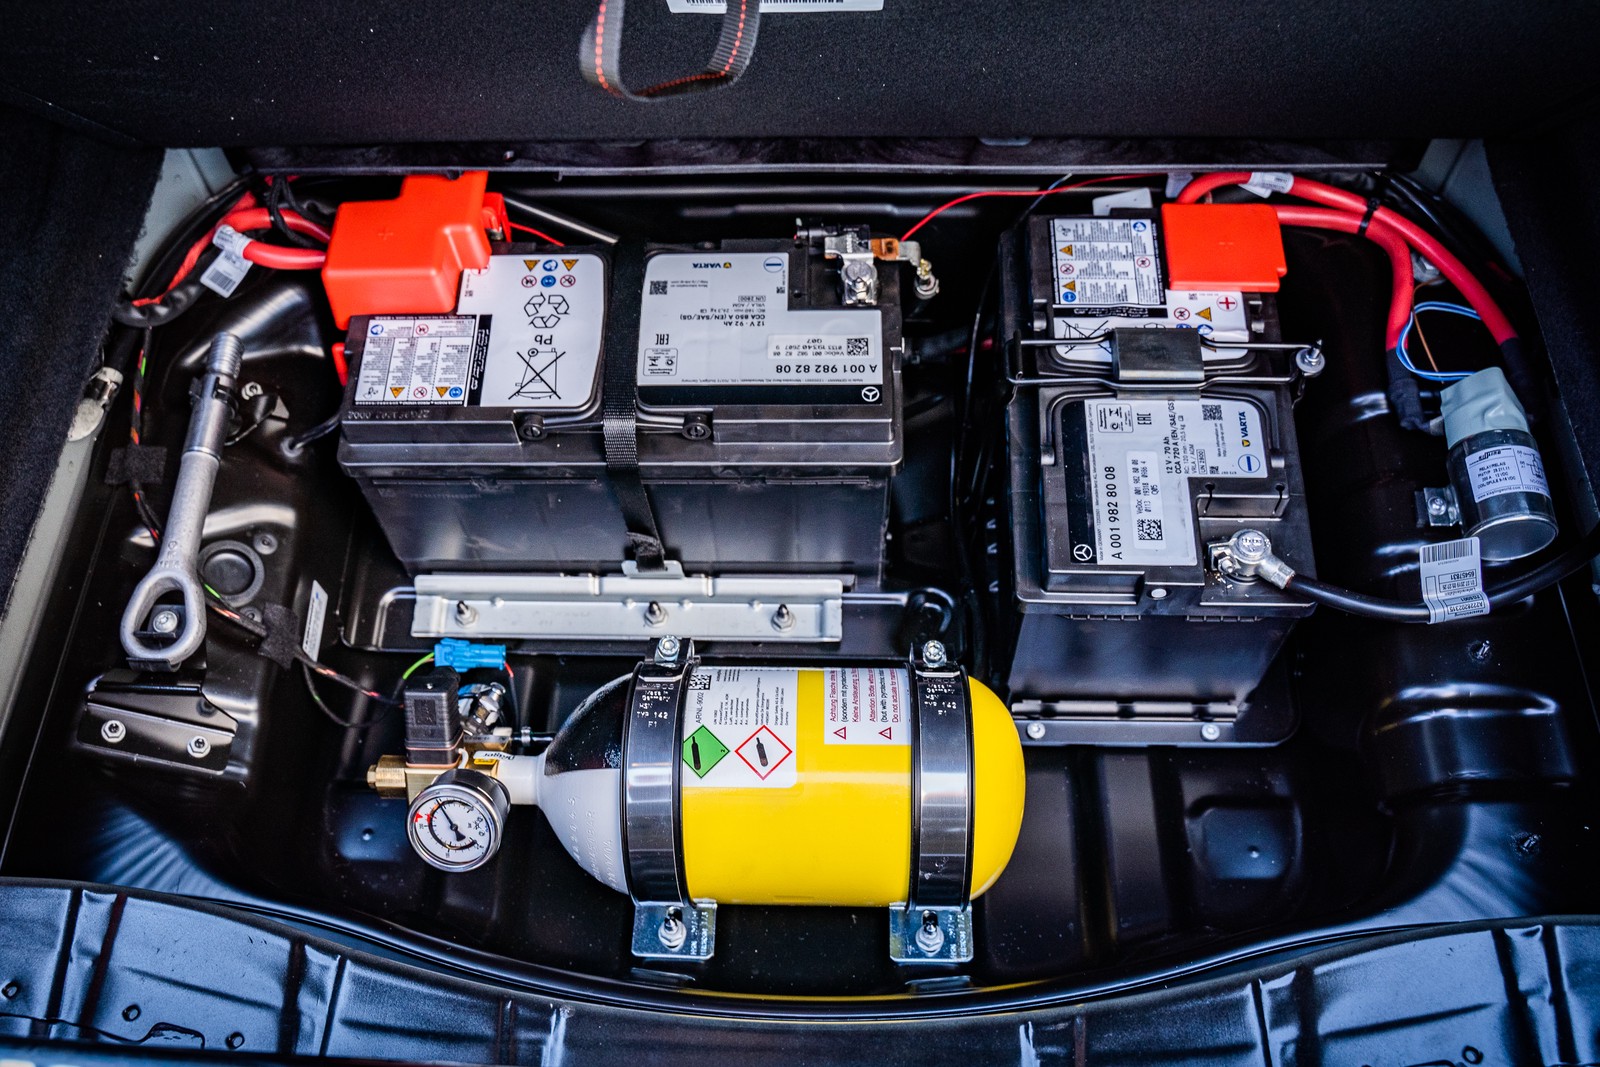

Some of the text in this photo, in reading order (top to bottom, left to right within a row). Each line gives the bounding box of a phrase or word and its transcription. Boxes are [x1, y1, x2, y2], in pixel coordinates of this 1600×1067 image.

[535, 334, 553, 345] Pb
[656, 334, 669, 345] EAC
[776, 365, 877, 373] A 001 982 82 08
[1137, 413, 1152, 425] EAC
[1238, 412, 1248, 438] VARTA
[1163, 437, 1169, 445] Ah
[1164, 446, 1170, 454] 70
[1104, 466, 1115, 480] 08
[1106, 484, 1117, 497] 80
[1151, 485, 1159, 495] Q05
[1107, 502, 1119, 522] 982
[1110, 528, 1121, 548] 001
[1451, 571, 1475, 580] 65457831
[696, 692, 704, 724] ARNL-9002
[892, 714, 898, 722] Do
